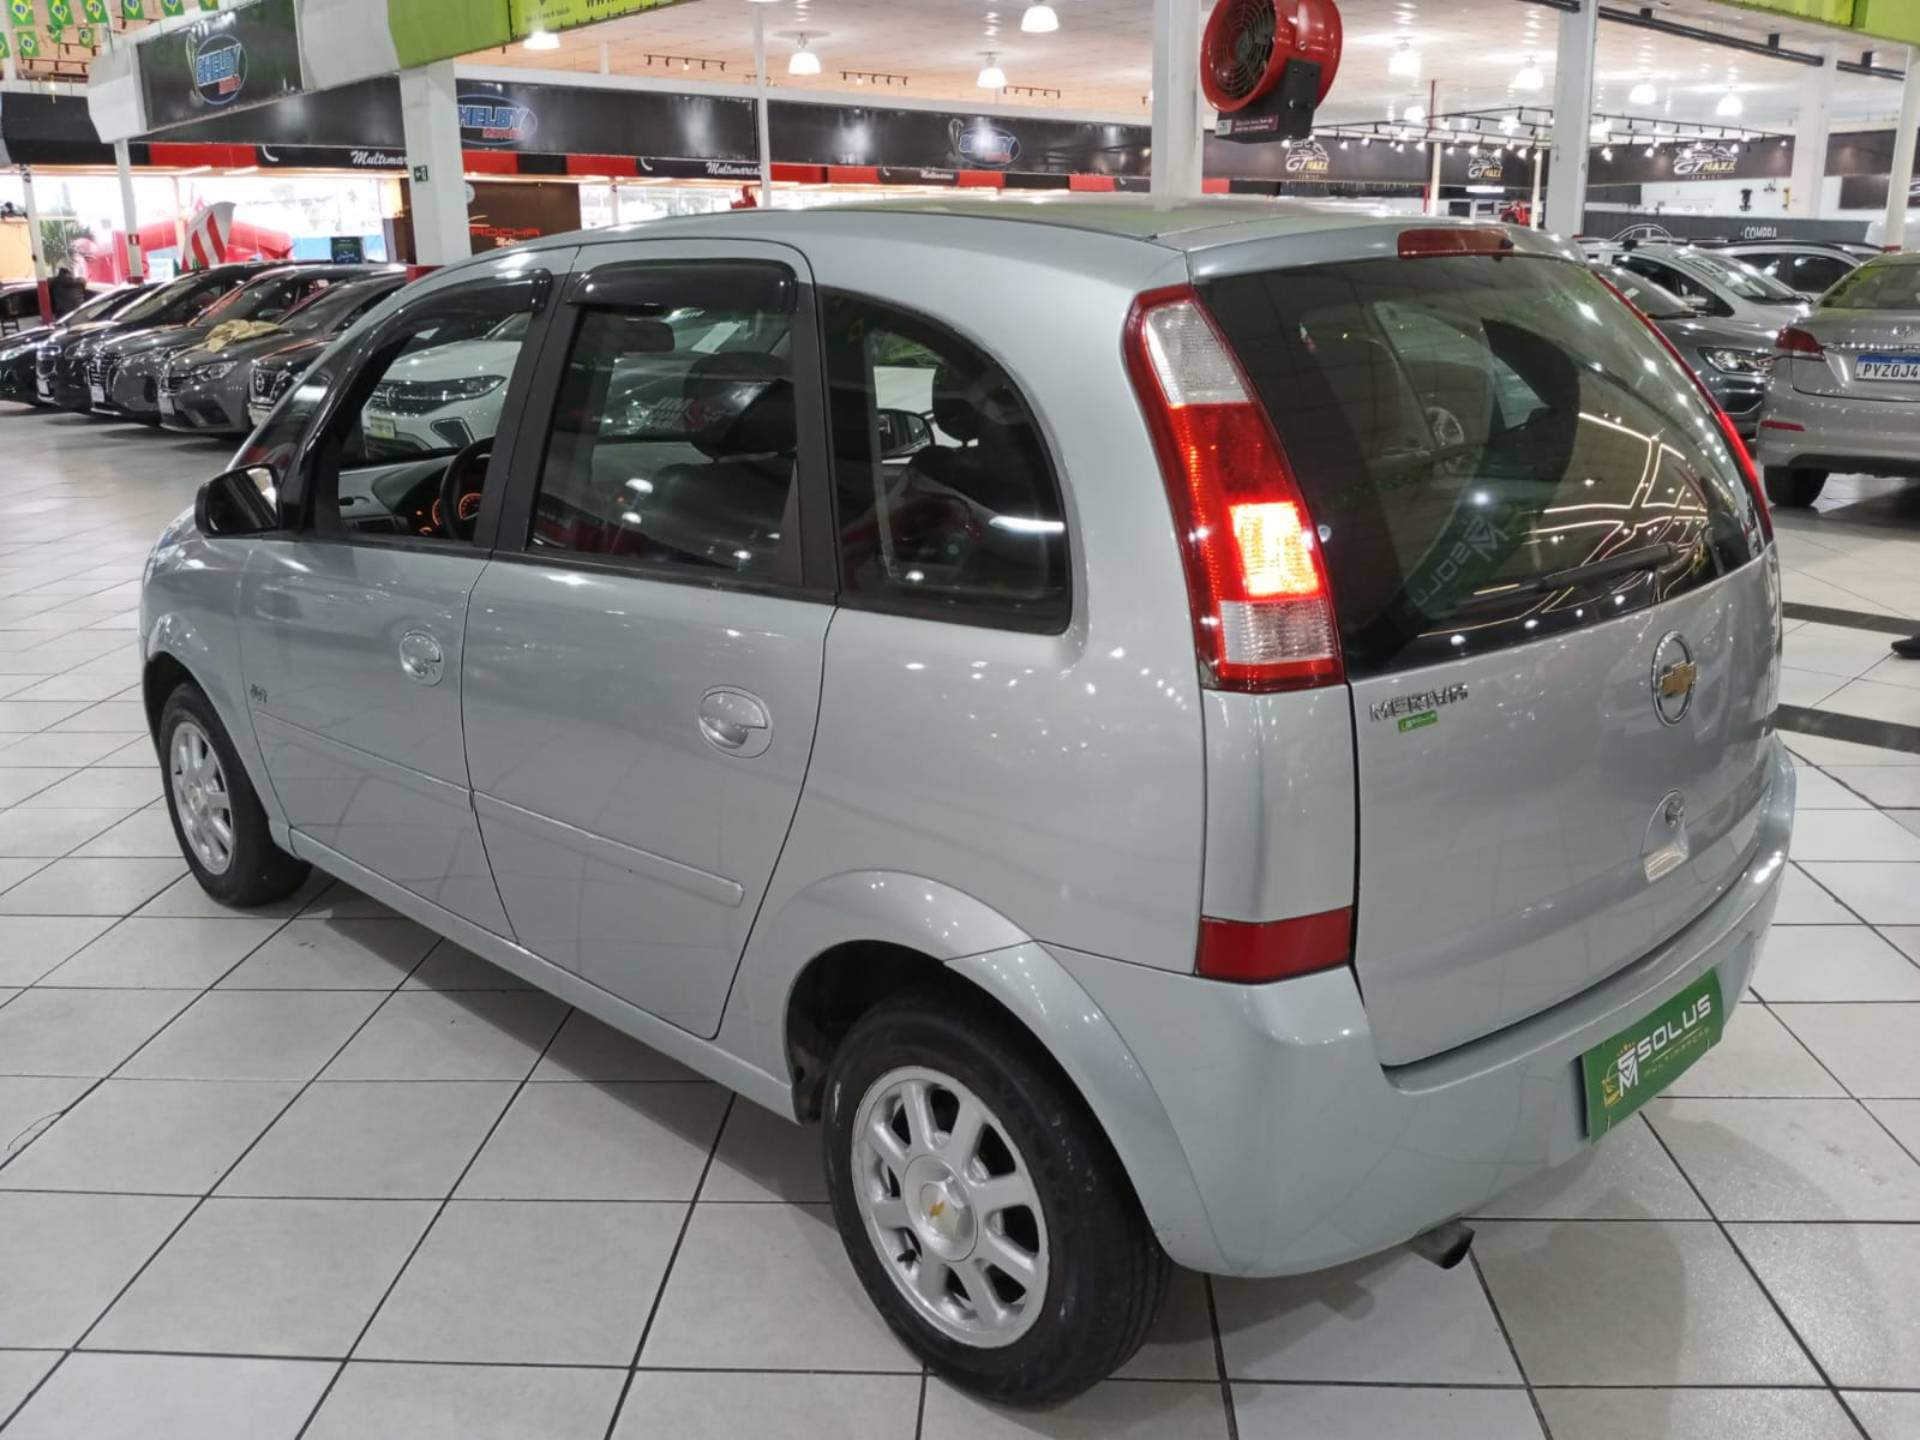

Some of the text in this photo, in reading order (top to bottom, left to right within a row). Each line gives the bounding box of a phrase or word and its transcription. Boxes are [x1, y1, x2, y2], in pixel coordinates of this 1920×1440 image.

[197, 44, 241, 87] SHELBY
[1744, 226, 1777, 239] COMPRA
[1637, 994, 1711, 1063] SOLUS
